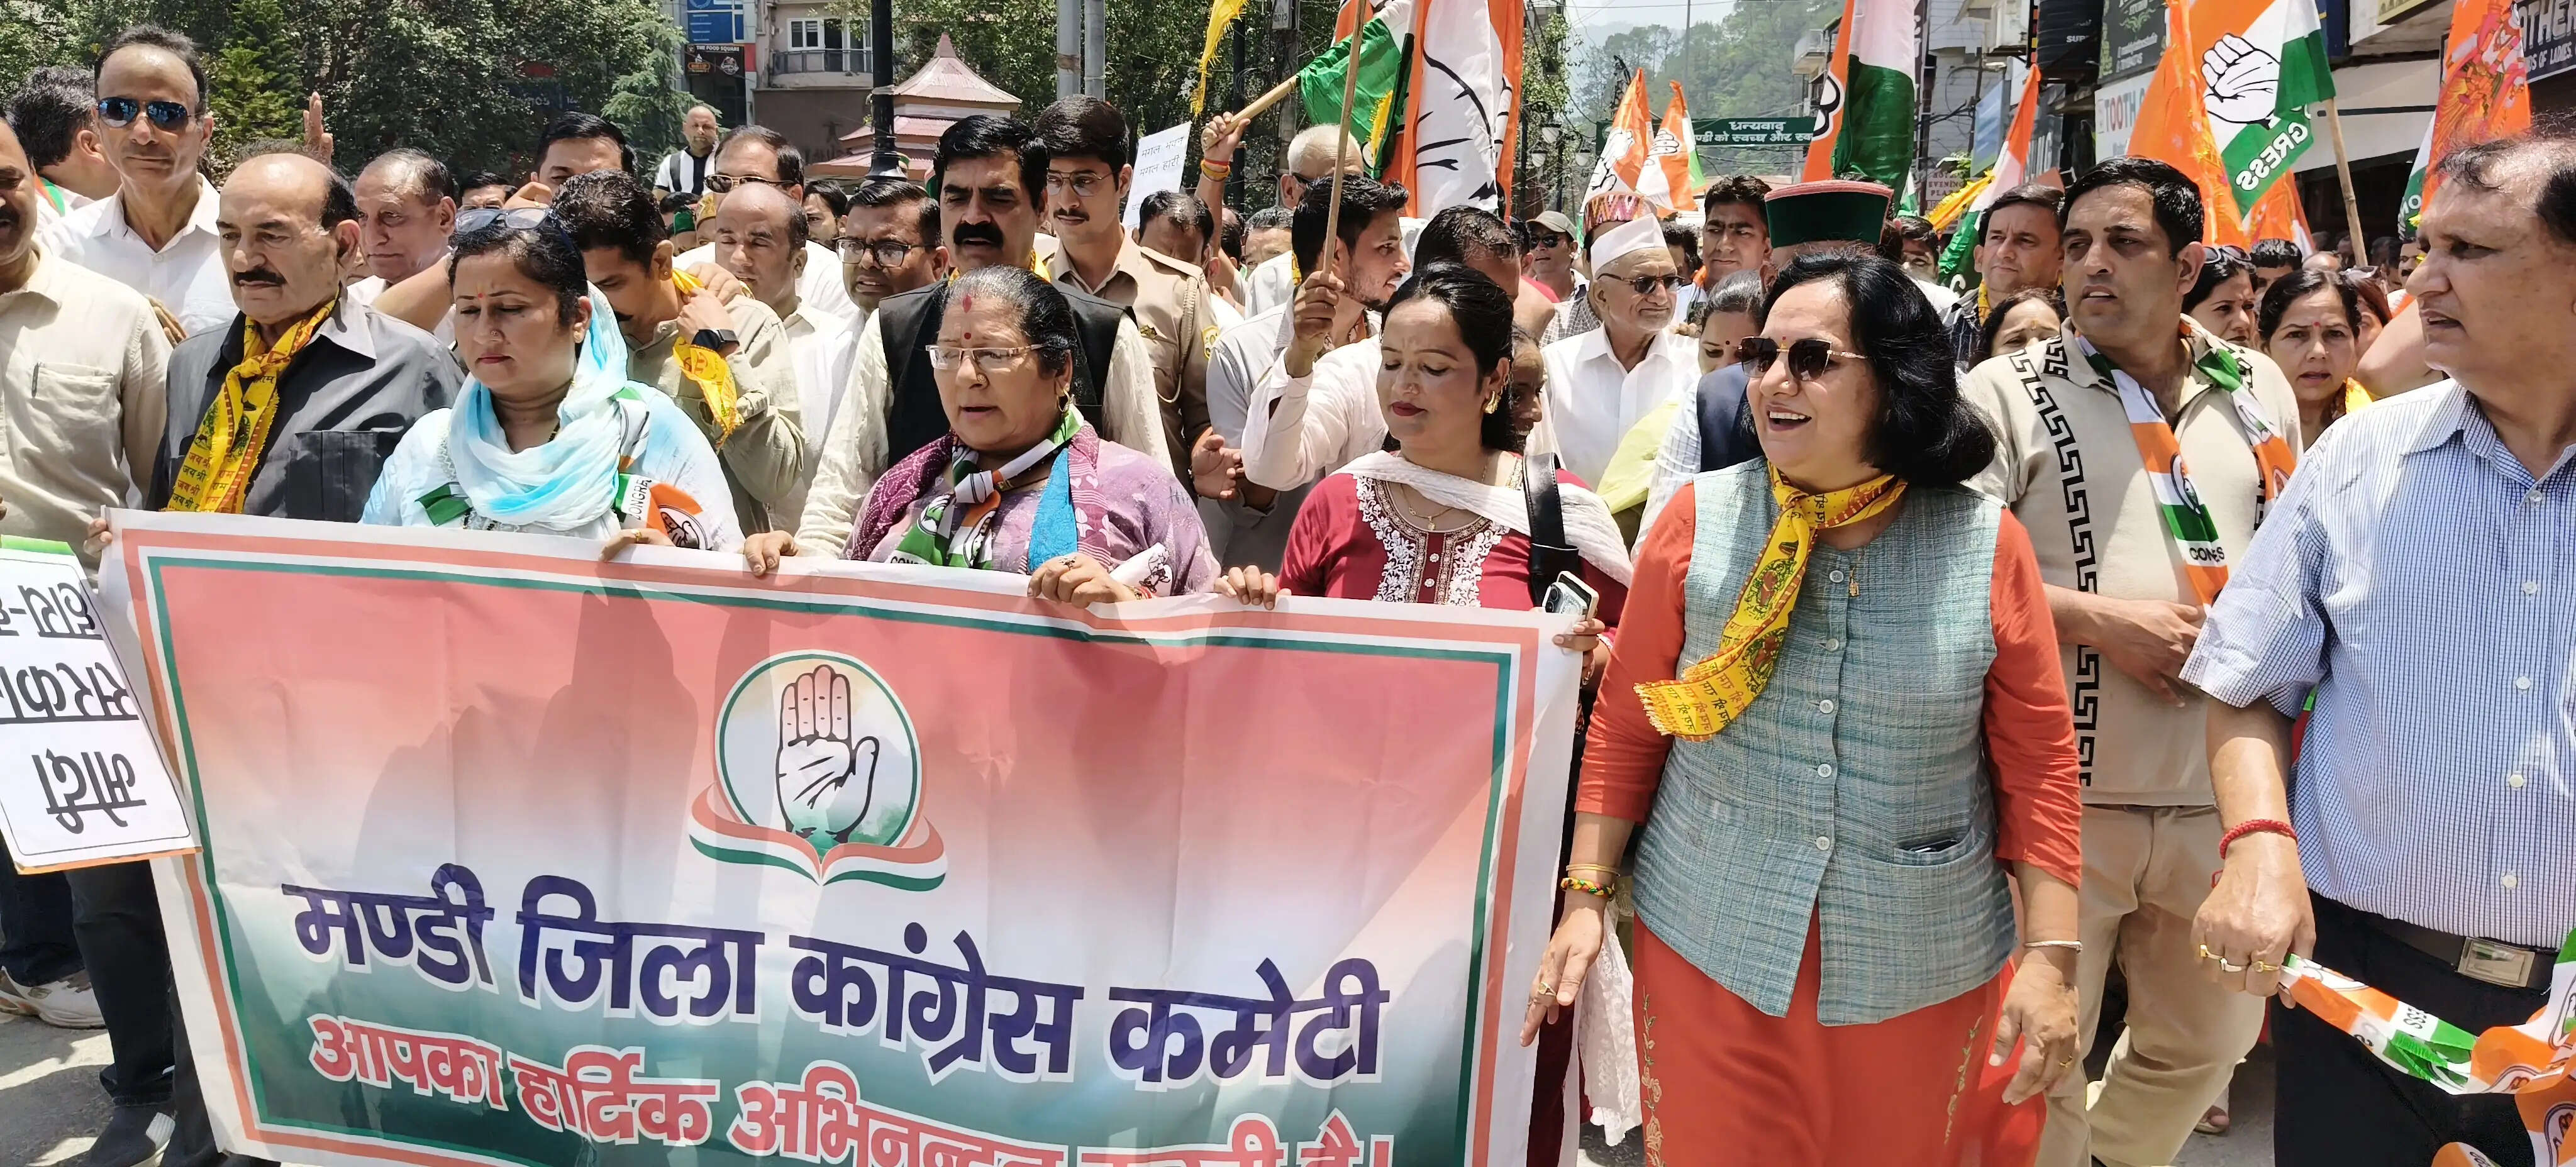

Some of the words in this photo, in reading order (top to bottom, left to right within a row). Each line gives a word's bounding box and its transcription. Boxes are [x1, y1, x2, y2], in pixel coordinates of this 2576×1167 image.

[1728, 121, 1786, 131] धन्यवाद
[2104, 91, 2136, 132] TOOTH
[1694, 131, 1714, 142] ण्डी
[1714, 131, 1729, 142] को
[182, 465, 197, 478] जय
[196, 470, 207, 483] श्री
[31, 747, 147, 835] मोदी
[281, 863, 495, 985] मण्डी
[516, 875, 765, 1017] जिला
[789, 922, 1085, 1075] कांग्रेस
[1109, 958, 1390, 1083] कमेटी
[312, 1018, 504, 1105] आपका
[510, 1051, 716, 1141] हार्दिक
